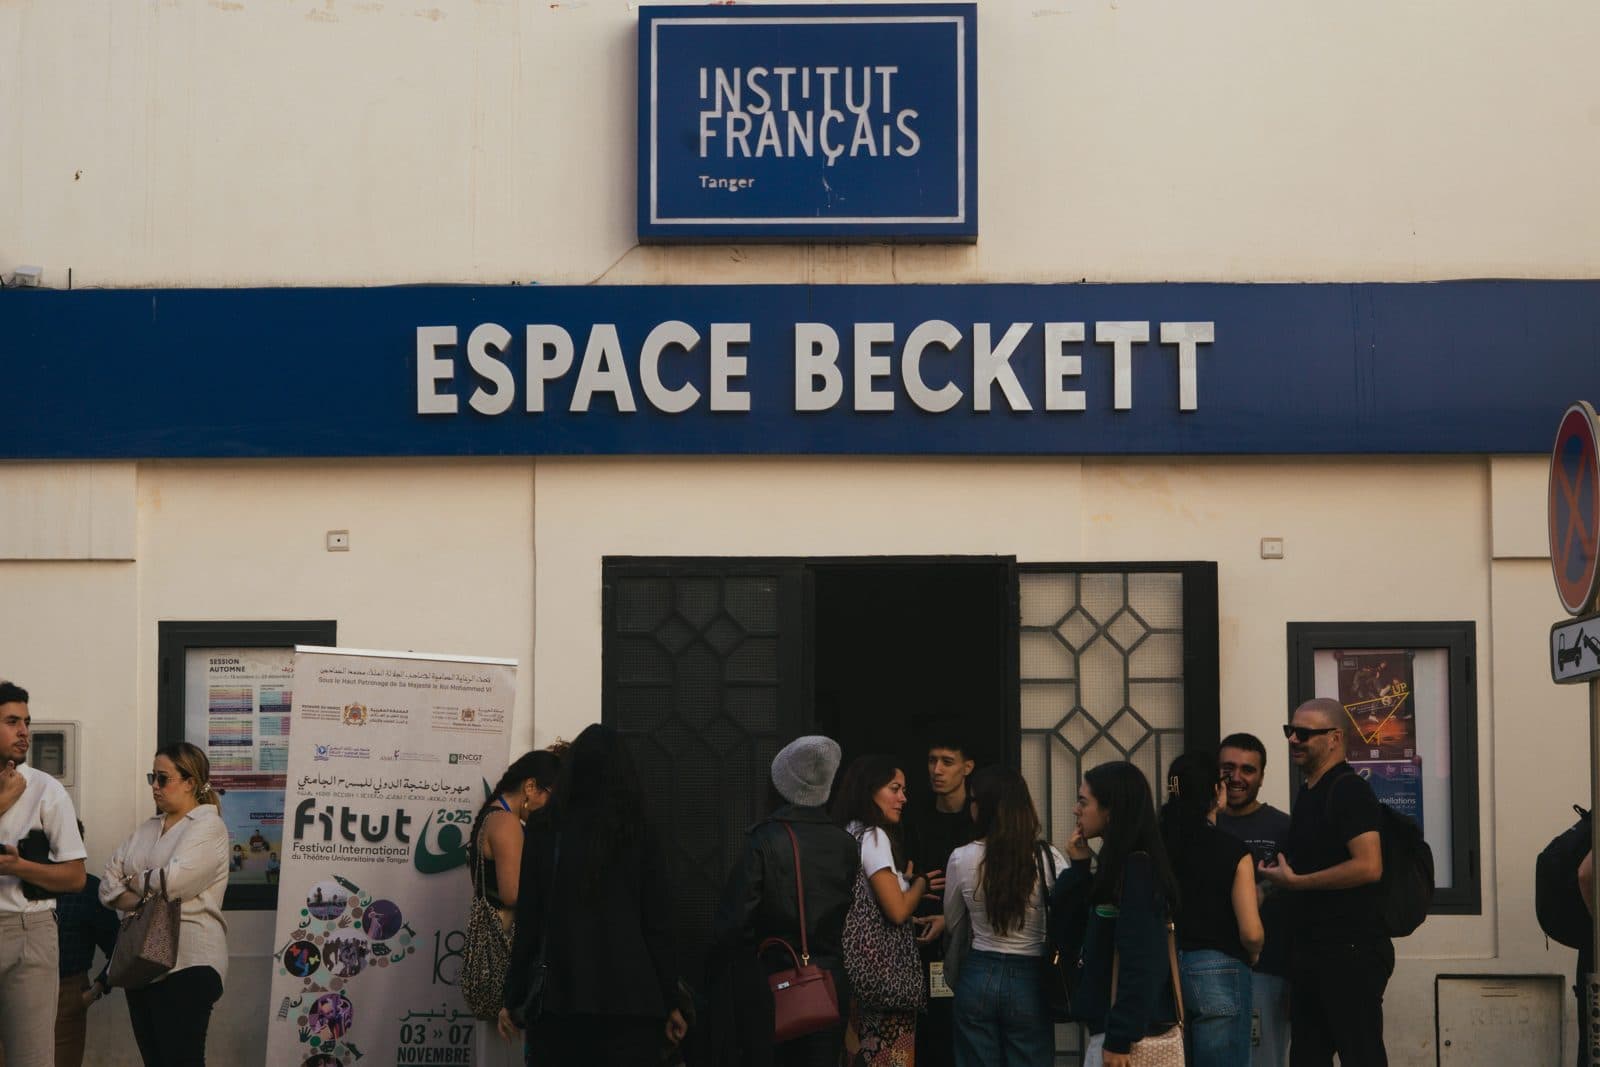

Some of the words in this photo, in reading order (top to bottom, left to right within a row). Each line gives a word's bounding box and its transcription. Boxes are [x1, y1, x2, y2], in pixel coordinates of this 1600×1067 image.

[700, 66, 898, 116] INSTITUT
[699, 175, 755, 192] Tanger
[416, 320, 751, 415] ESPACE
[795, 319, 1215, 413] BECKETT
[297, 772, 336, 790] الجامعي
[373, 776, 402, 794] الدولي
[403, 778, 430, 792] طنجة
[431, 778, 471, 794] مهرجان
[293, 842, 336, 854] Festival
[339, 844, 410, 856] International
[331, 855, 375, 863] Universitaire
[386, 857, 409, 865] Tanger
[400, 1024, 426, 1044] 03
[448, 1024, 474, 1045] 07
[397, 1047, 471, 1063] NOVEMBRE
